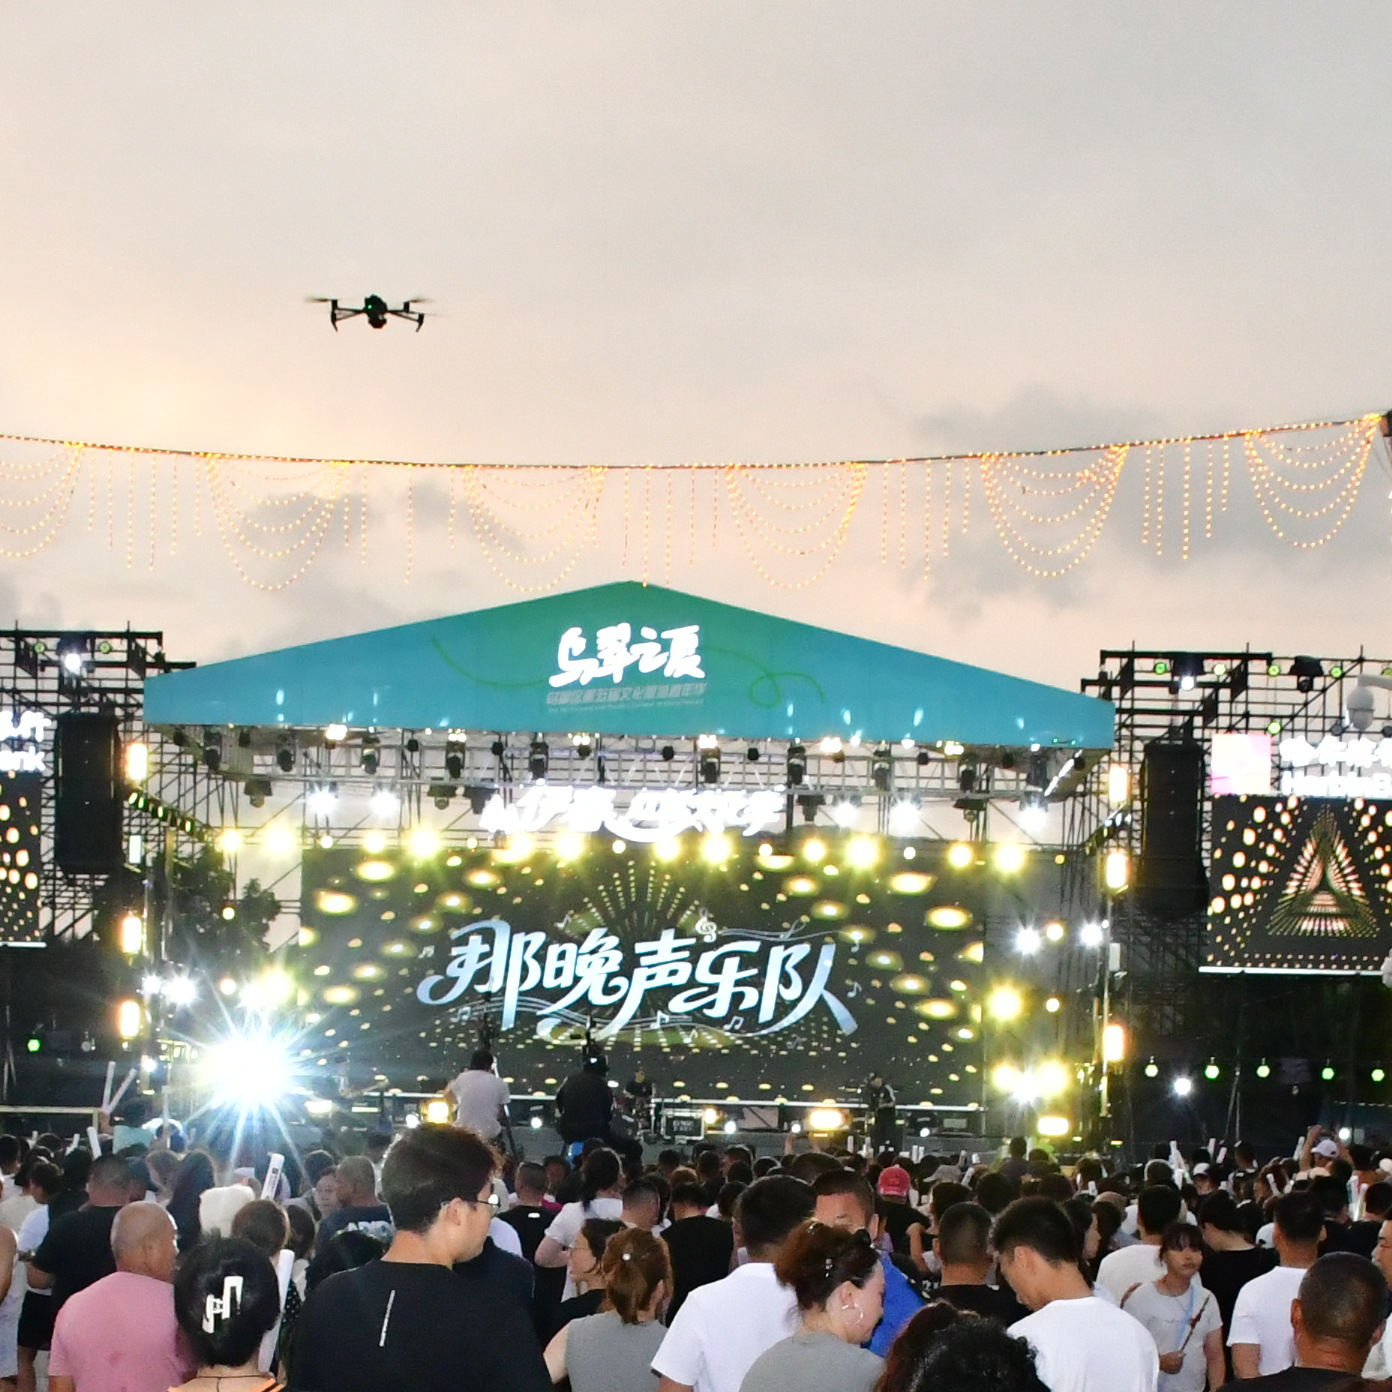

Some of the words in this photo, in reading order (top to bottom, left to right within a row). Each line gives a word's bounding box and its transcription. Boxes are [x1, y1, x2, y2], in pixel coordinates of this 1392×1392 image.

[417, 919, 859, 1046] 那晚声乐队
